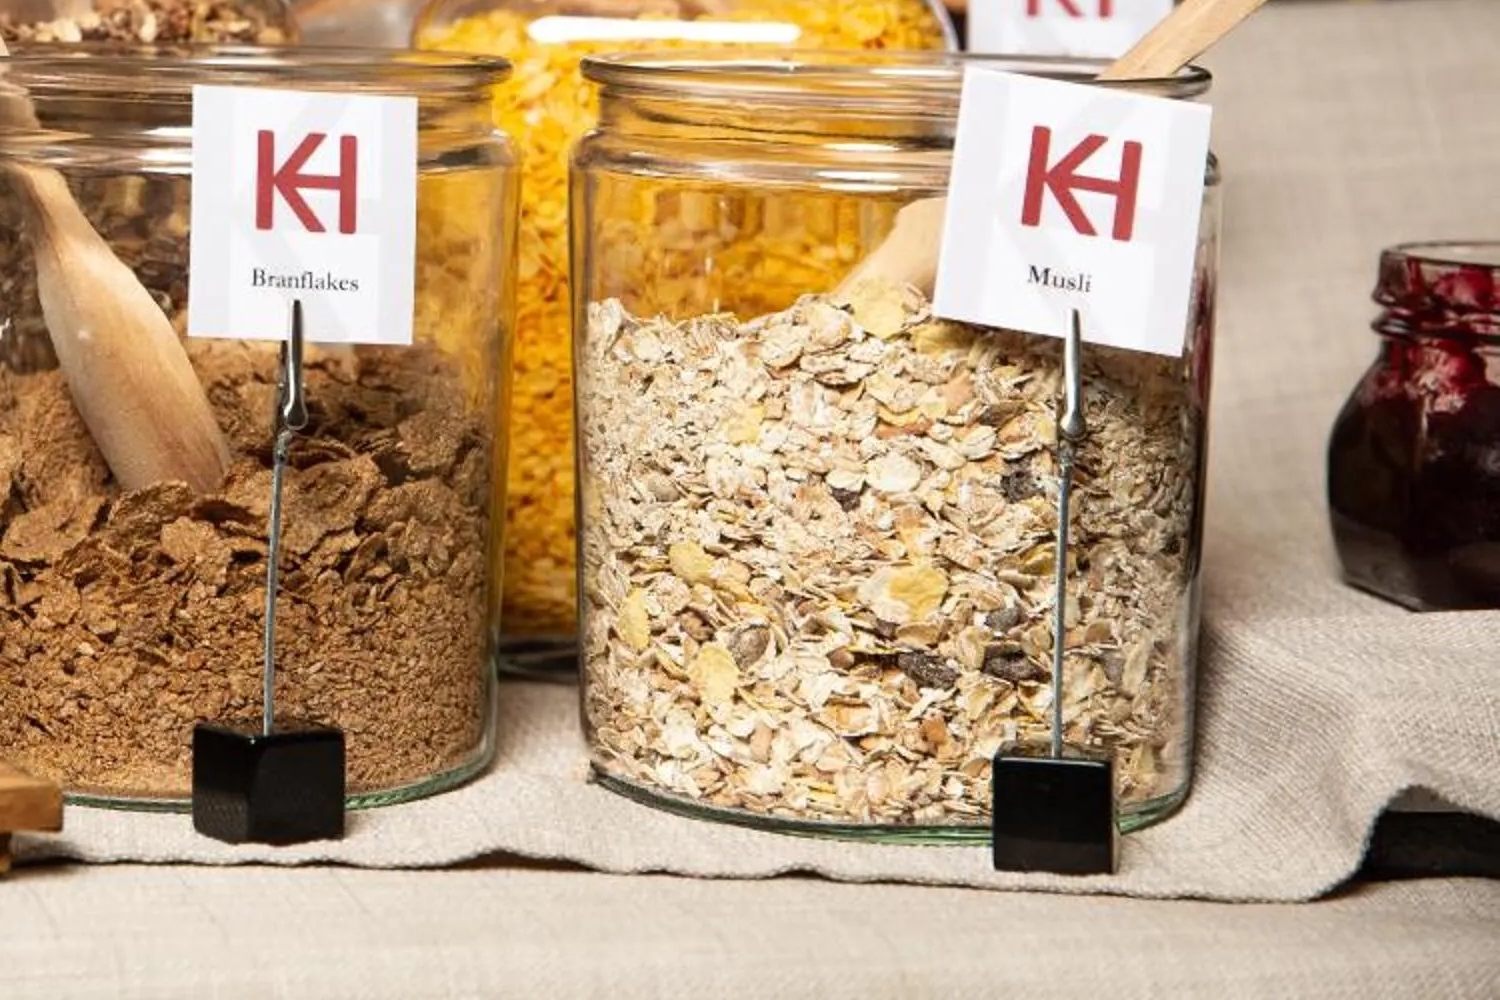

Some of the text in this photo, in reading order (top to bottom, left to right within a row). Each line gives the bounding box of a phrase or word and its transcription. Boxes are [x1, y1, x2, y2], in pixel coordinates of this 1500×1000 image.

[255, 129, 358, 235] KH
[1020, 125, 1143, 243] KH
[251, 267, 360, 292] Branflakes
[1027, 264, 1092, 293] Musli
